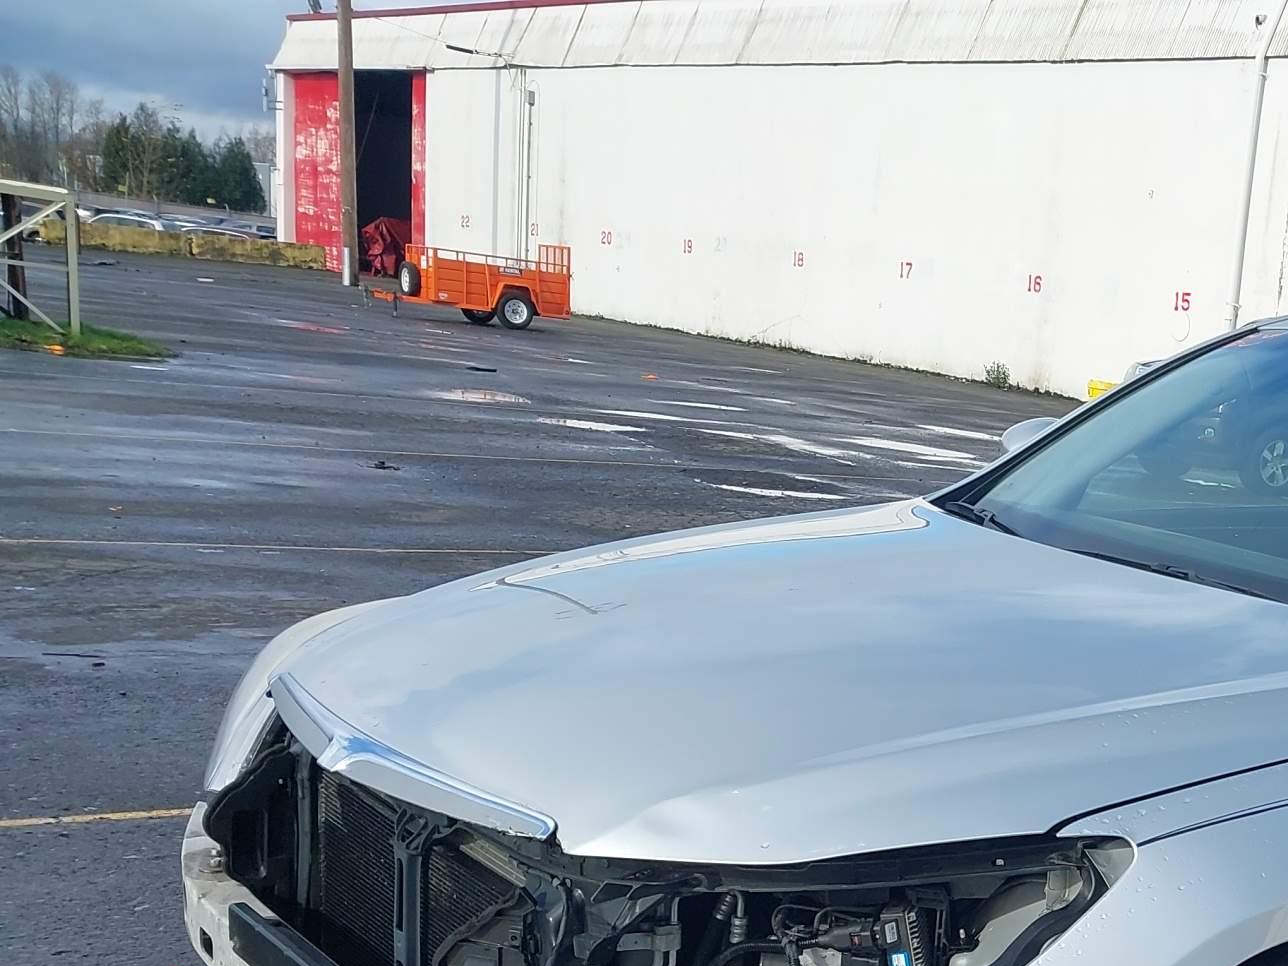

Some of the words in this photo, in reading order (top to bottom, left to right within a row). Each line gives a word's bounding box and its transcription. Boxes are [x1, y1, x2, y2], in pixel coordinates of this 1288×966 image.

[461, 215, 470, 228] 22
[530, 223, 539, 236] 21
[600, 231, 612, 245] 20
[683, 239, 693, 254] 19
[793, 251, 804, 267] 18
[899, 261, 913, 279] 17
[1027, 274, 1042, 293] 16
[1174, 292, 1191, 311] 15
